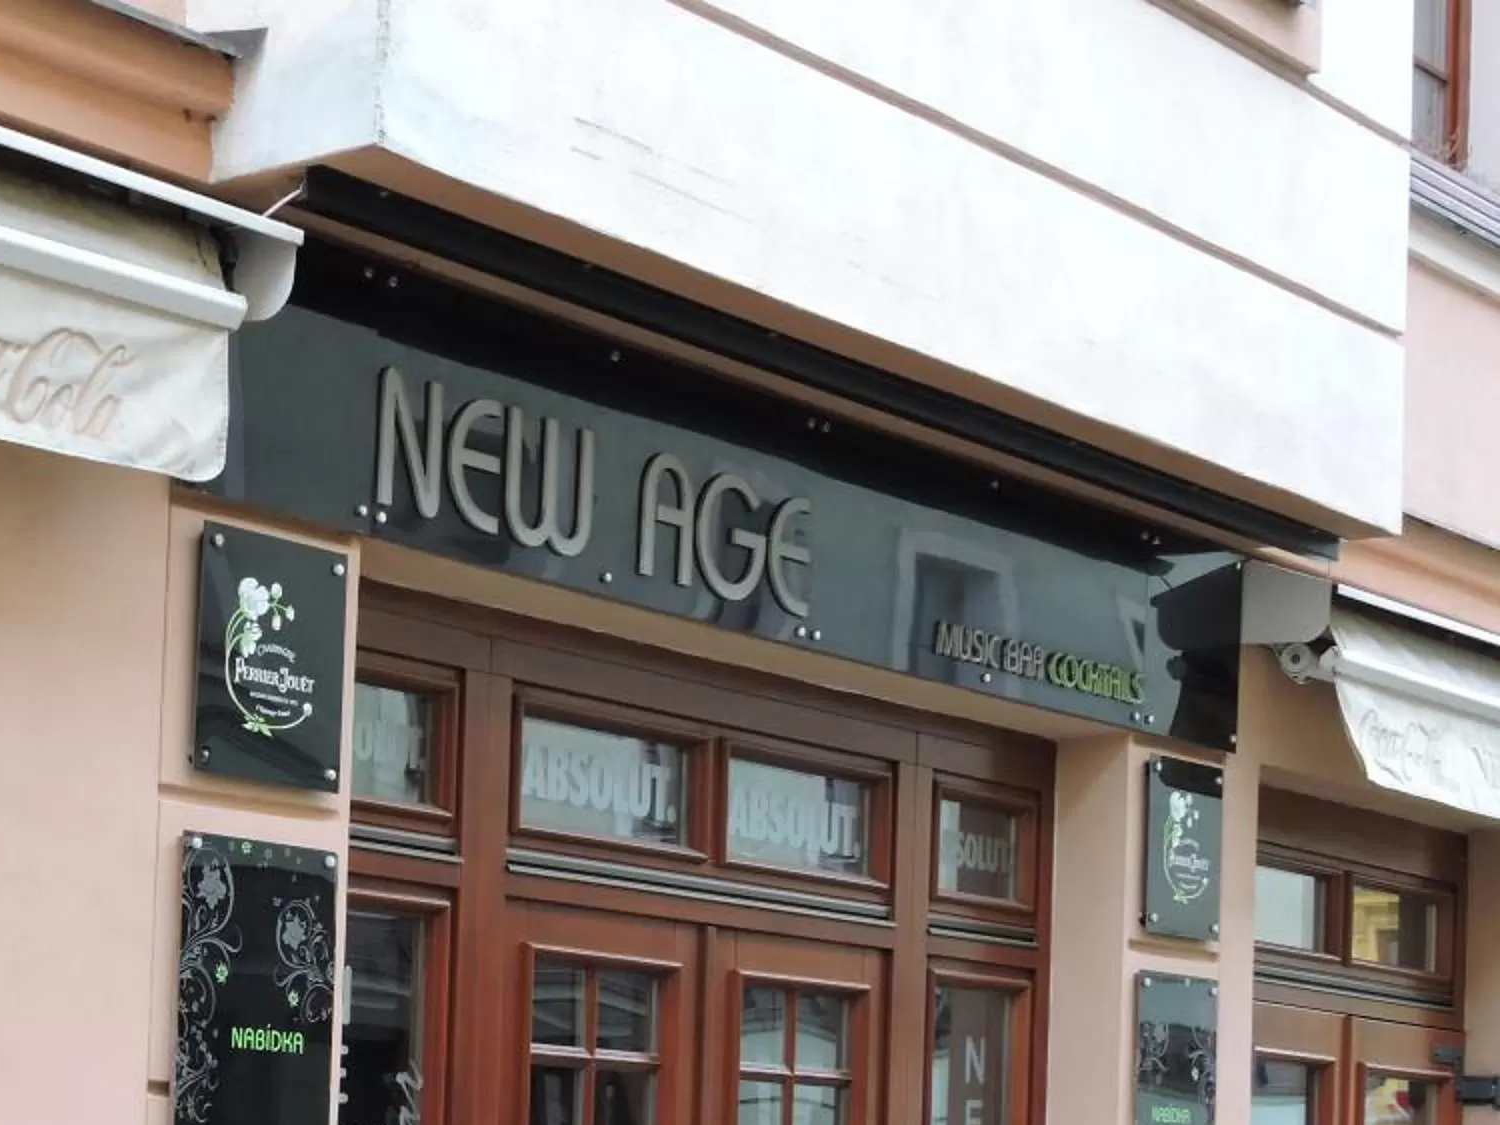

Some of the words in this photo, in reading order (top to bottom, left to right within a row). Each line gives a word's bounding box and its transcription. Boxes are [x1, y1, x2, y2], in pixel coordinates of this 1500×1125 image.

[376, 364, 597, 557] NEW
[638, 452, 814, 619] AGE
[934, 619, 1002, 670] MUSIC
[1003, 636, 1046, 681] BAR
[1049, 651, 1148, 704] COCKTAILS
[231, 1023, 304, 1055] NABÍDKA
